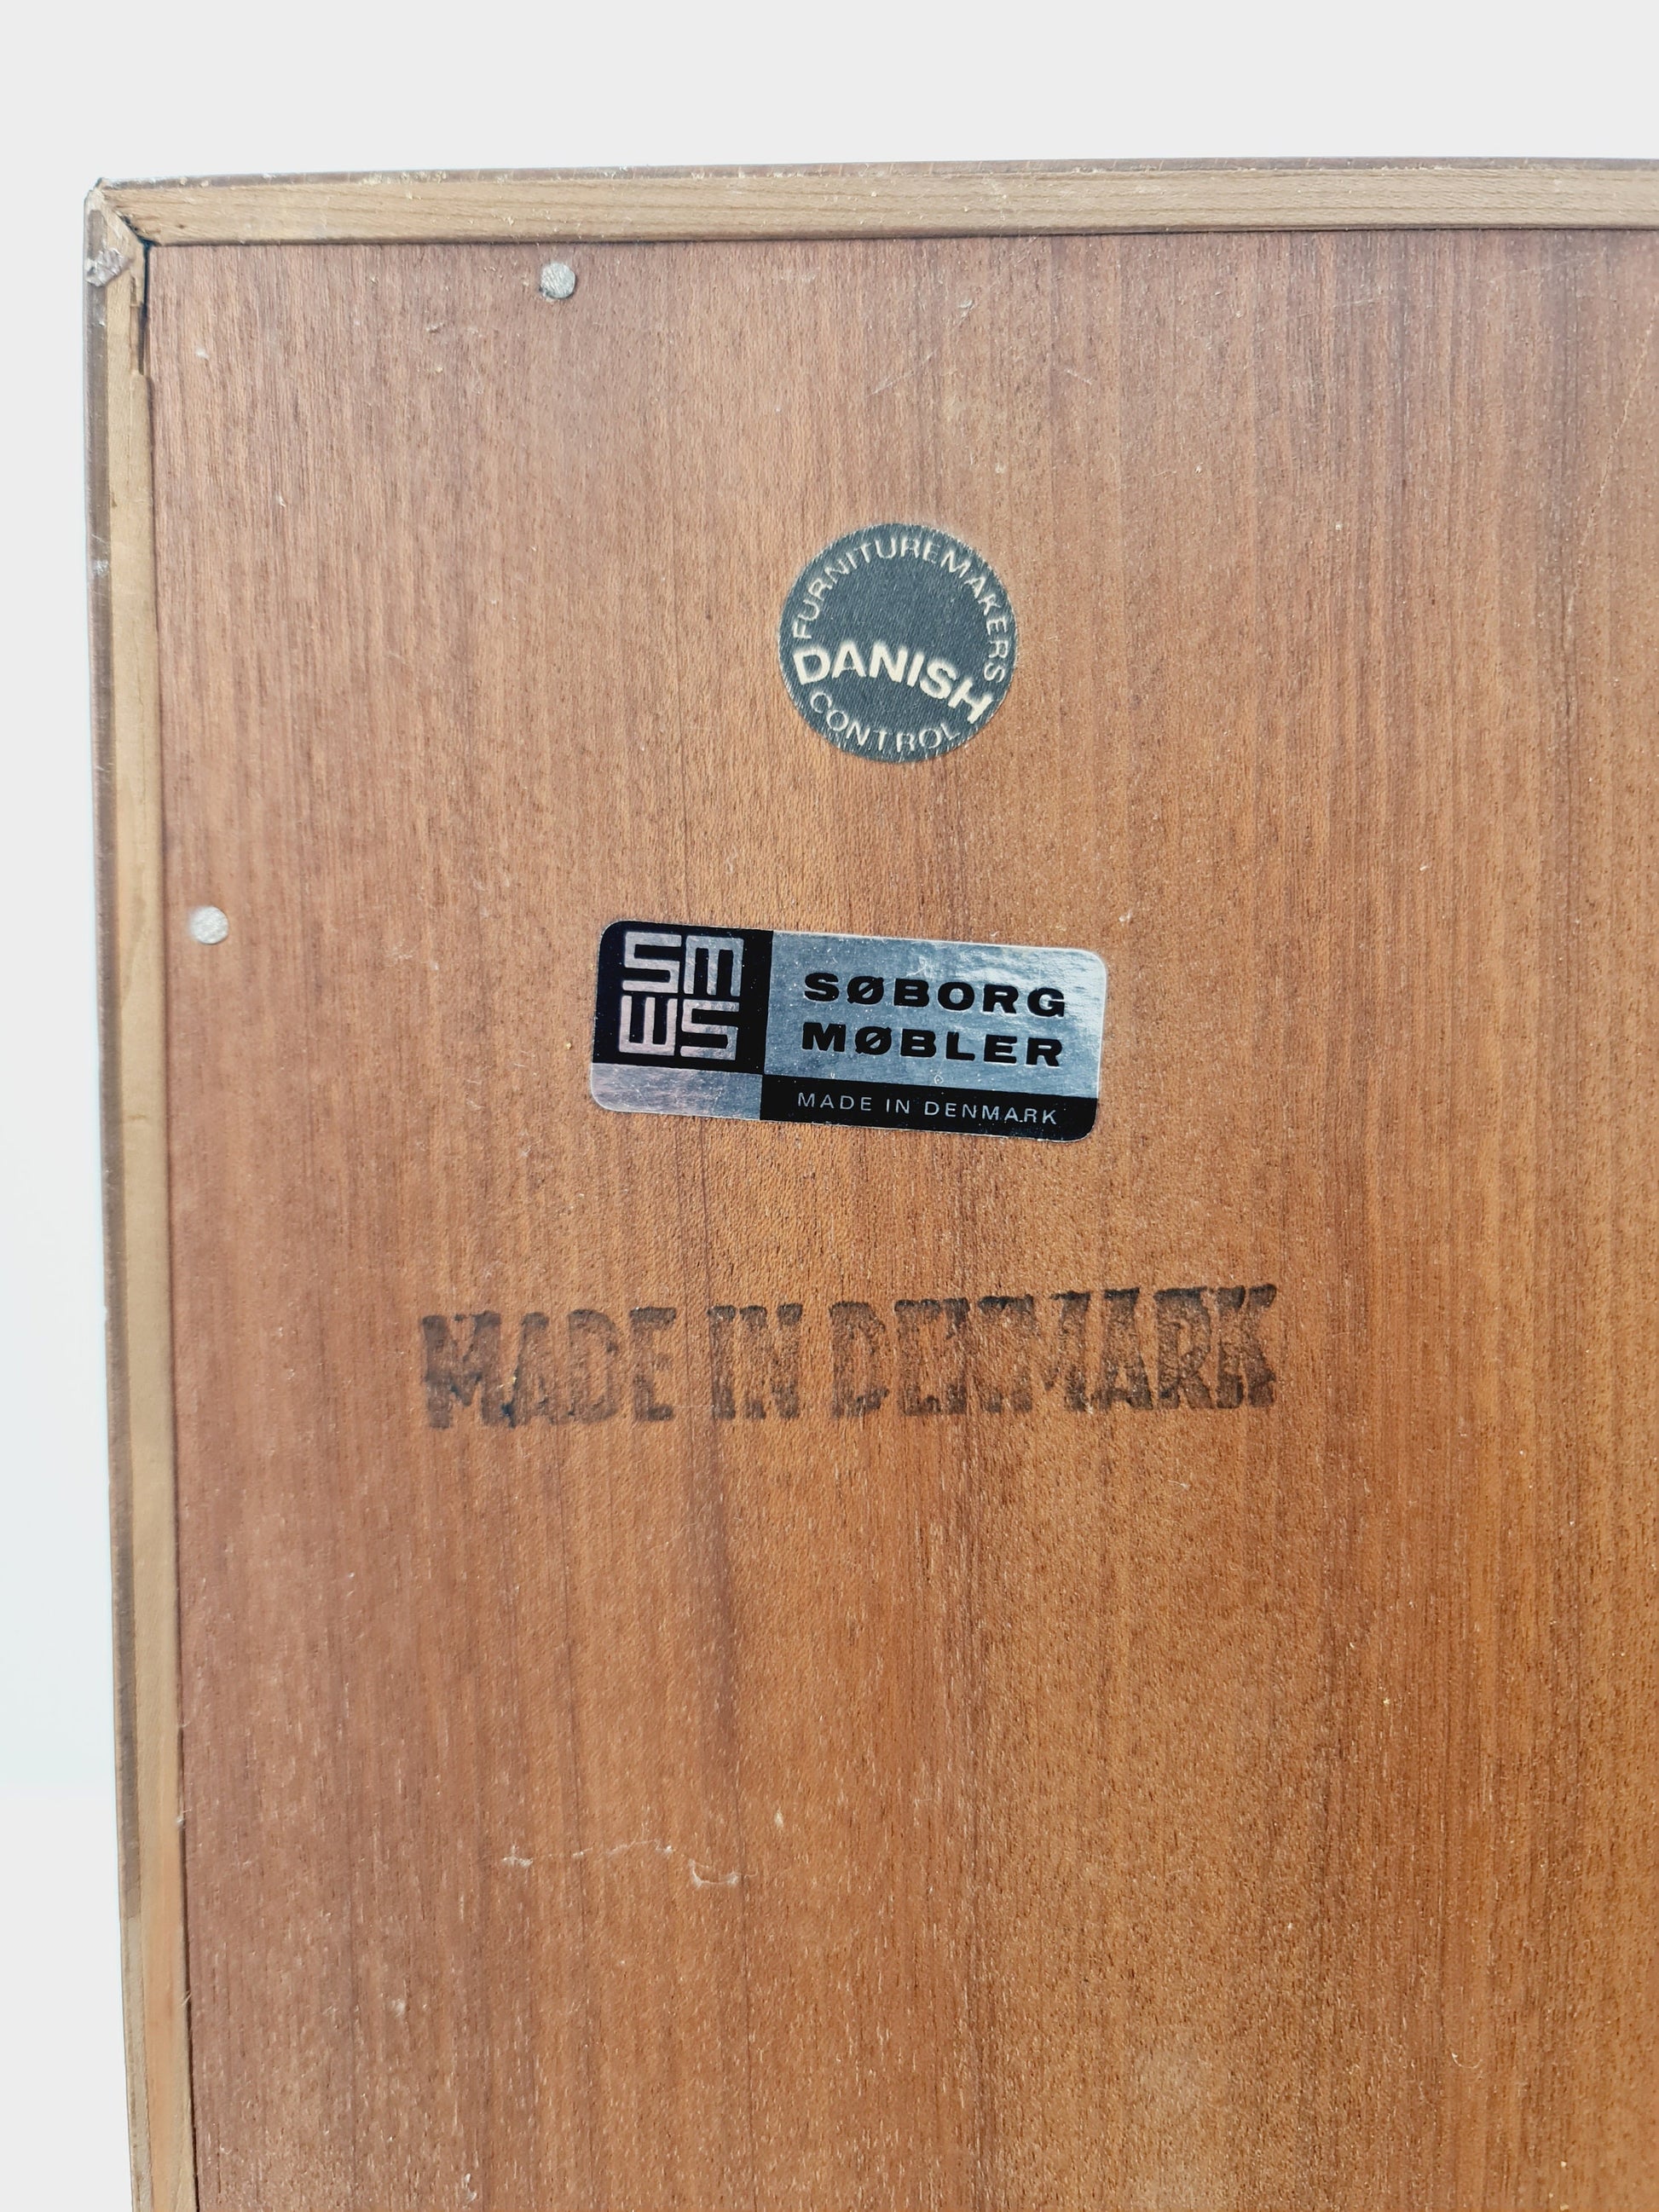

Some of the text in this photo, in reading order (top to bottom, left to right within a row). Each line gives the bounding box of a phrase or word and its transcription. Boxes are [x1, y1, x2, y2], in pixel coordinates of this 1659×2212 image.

[792, 536, 1009, 684] FURNITUREMAKERS
[793, 641, 992, 724] DANISH
[810, 691, 961, 753] CONTROL
[804, 972, 1066, 1017] SØBORG
[801, 1021, 1063, 1067] MØBLER
[797, 1092, 1056, 1125] MADE IN DENMARK
[423, 1284, 1277, 1429] MADE IN DENMARK
